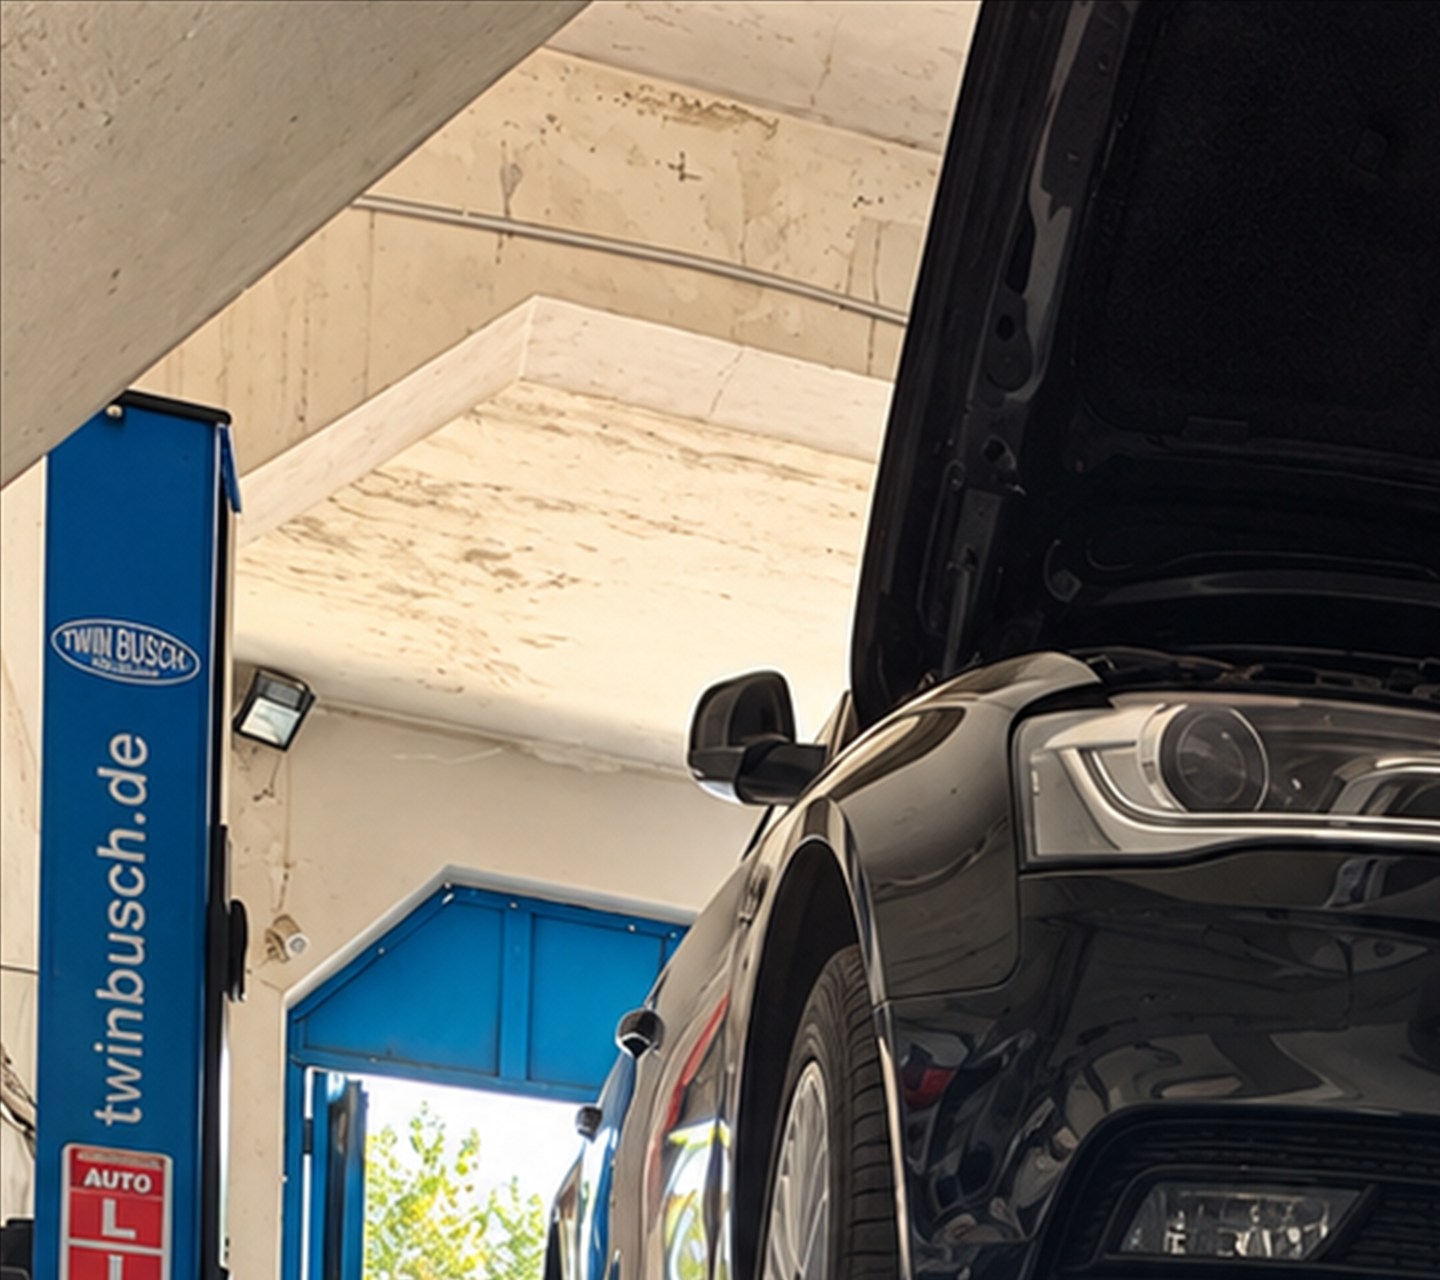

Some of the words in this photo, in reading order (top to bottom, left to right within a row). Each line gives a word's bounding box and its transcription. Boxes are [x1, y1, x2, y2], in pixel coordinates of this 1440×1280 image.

[63, 627, 113, 658] TWIN
[115, 628, 187, 670] BUSCH
[94, 732, 149, 1126] twinbusch.de
[84, 1167, 152, 1194] AUTO
